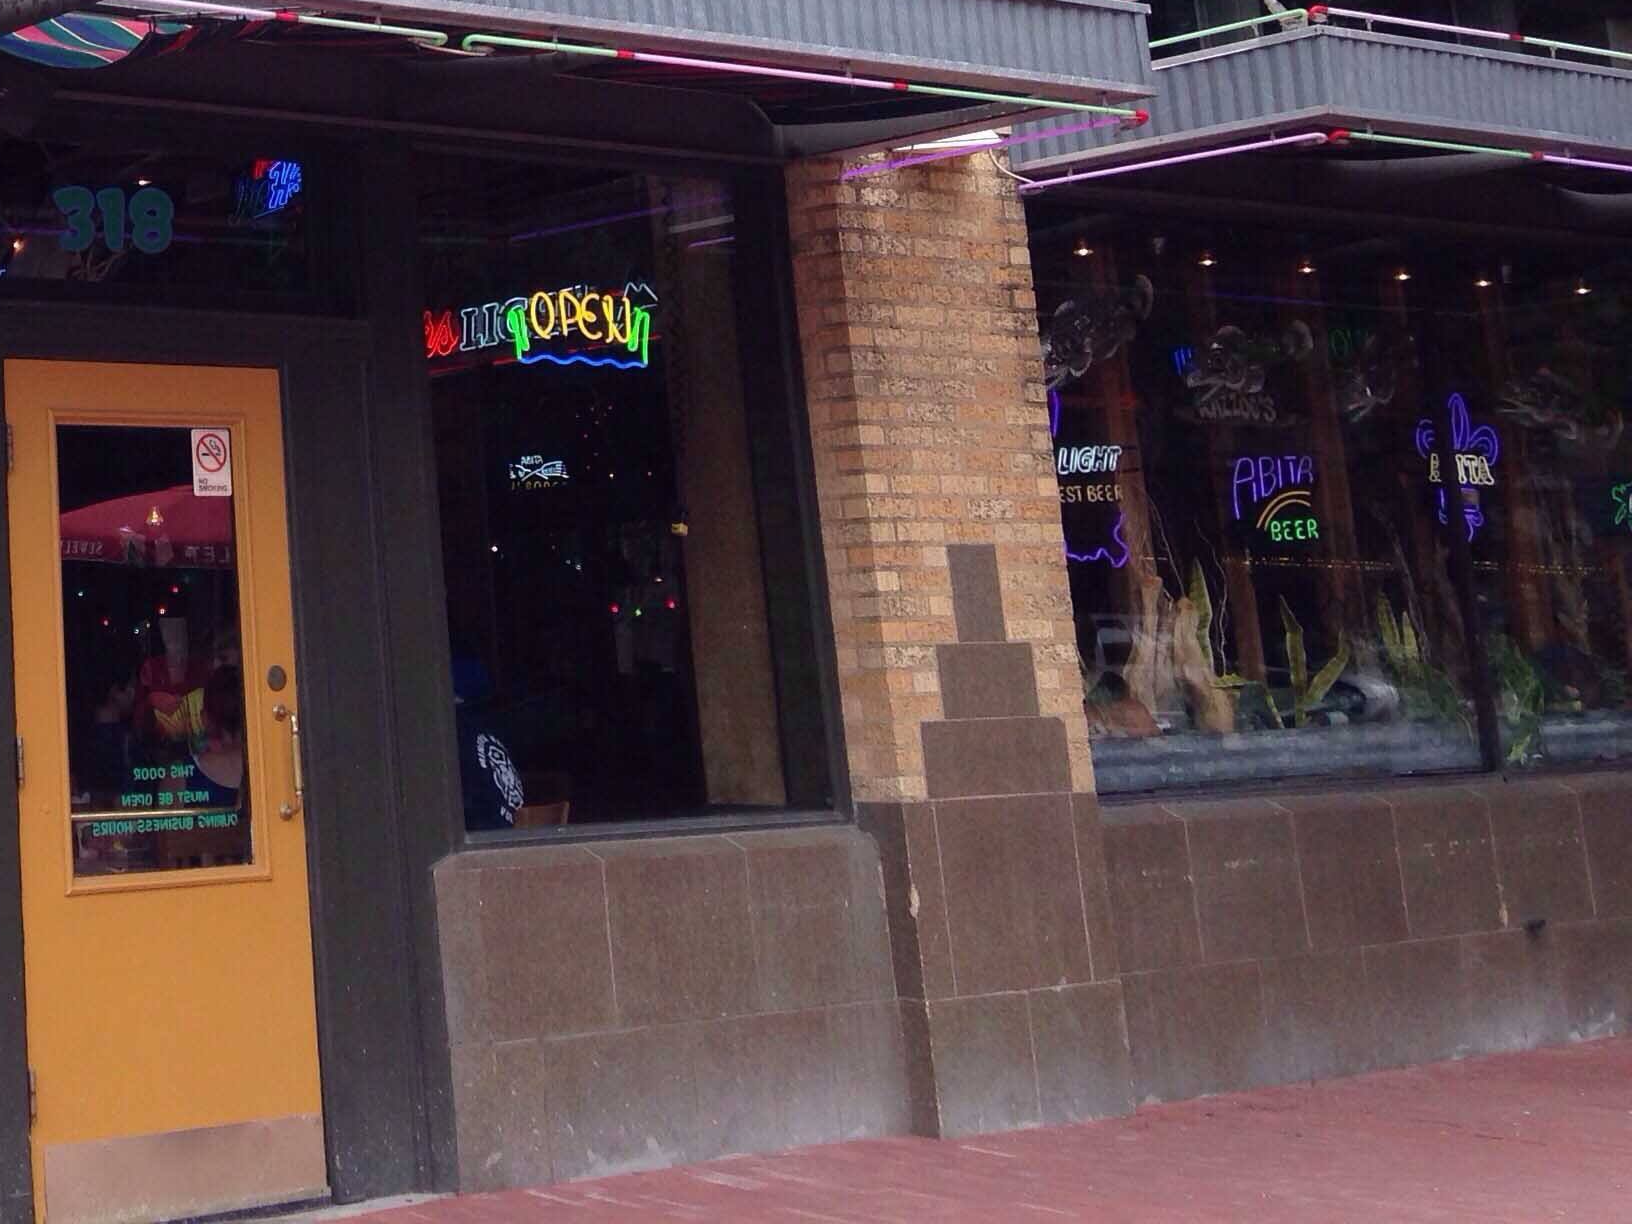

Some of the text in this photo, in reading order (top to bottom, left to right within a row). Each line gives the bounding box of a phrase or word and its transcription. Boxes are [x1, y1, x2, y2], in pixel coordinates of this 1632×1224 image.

[53, 185, 174, 254] 318
[530, 290, 631, 345] OPEN
[1057, 444, 1123, 476] LIGHT
[1428, 452, 1495, 486] AITA
[1086, 484, 1124, 503] BEER
[1232, 455, 1314, 520] ABITA
[1270, 518, 1319, 542] BEER
